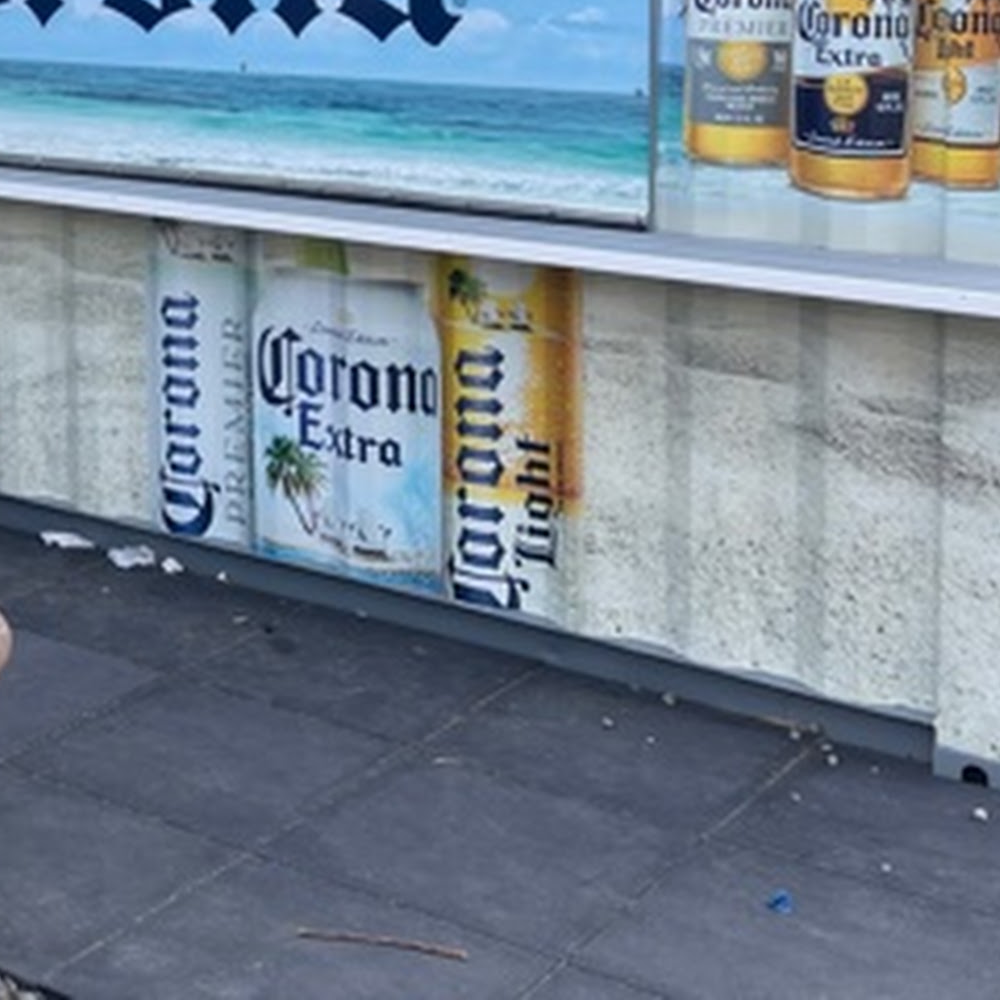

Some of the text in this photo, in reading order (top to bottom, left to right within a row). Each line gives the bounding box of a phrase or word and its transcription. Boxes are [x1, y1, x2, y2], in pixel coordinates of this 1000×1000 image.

[814, 46, 882, 67] Extra
[160, 292, 220, 536] Corona
[257, 325, 438, 417] Corona
[300, 402, 402, 468] Extra
[514, 434, 559, 570] Light
